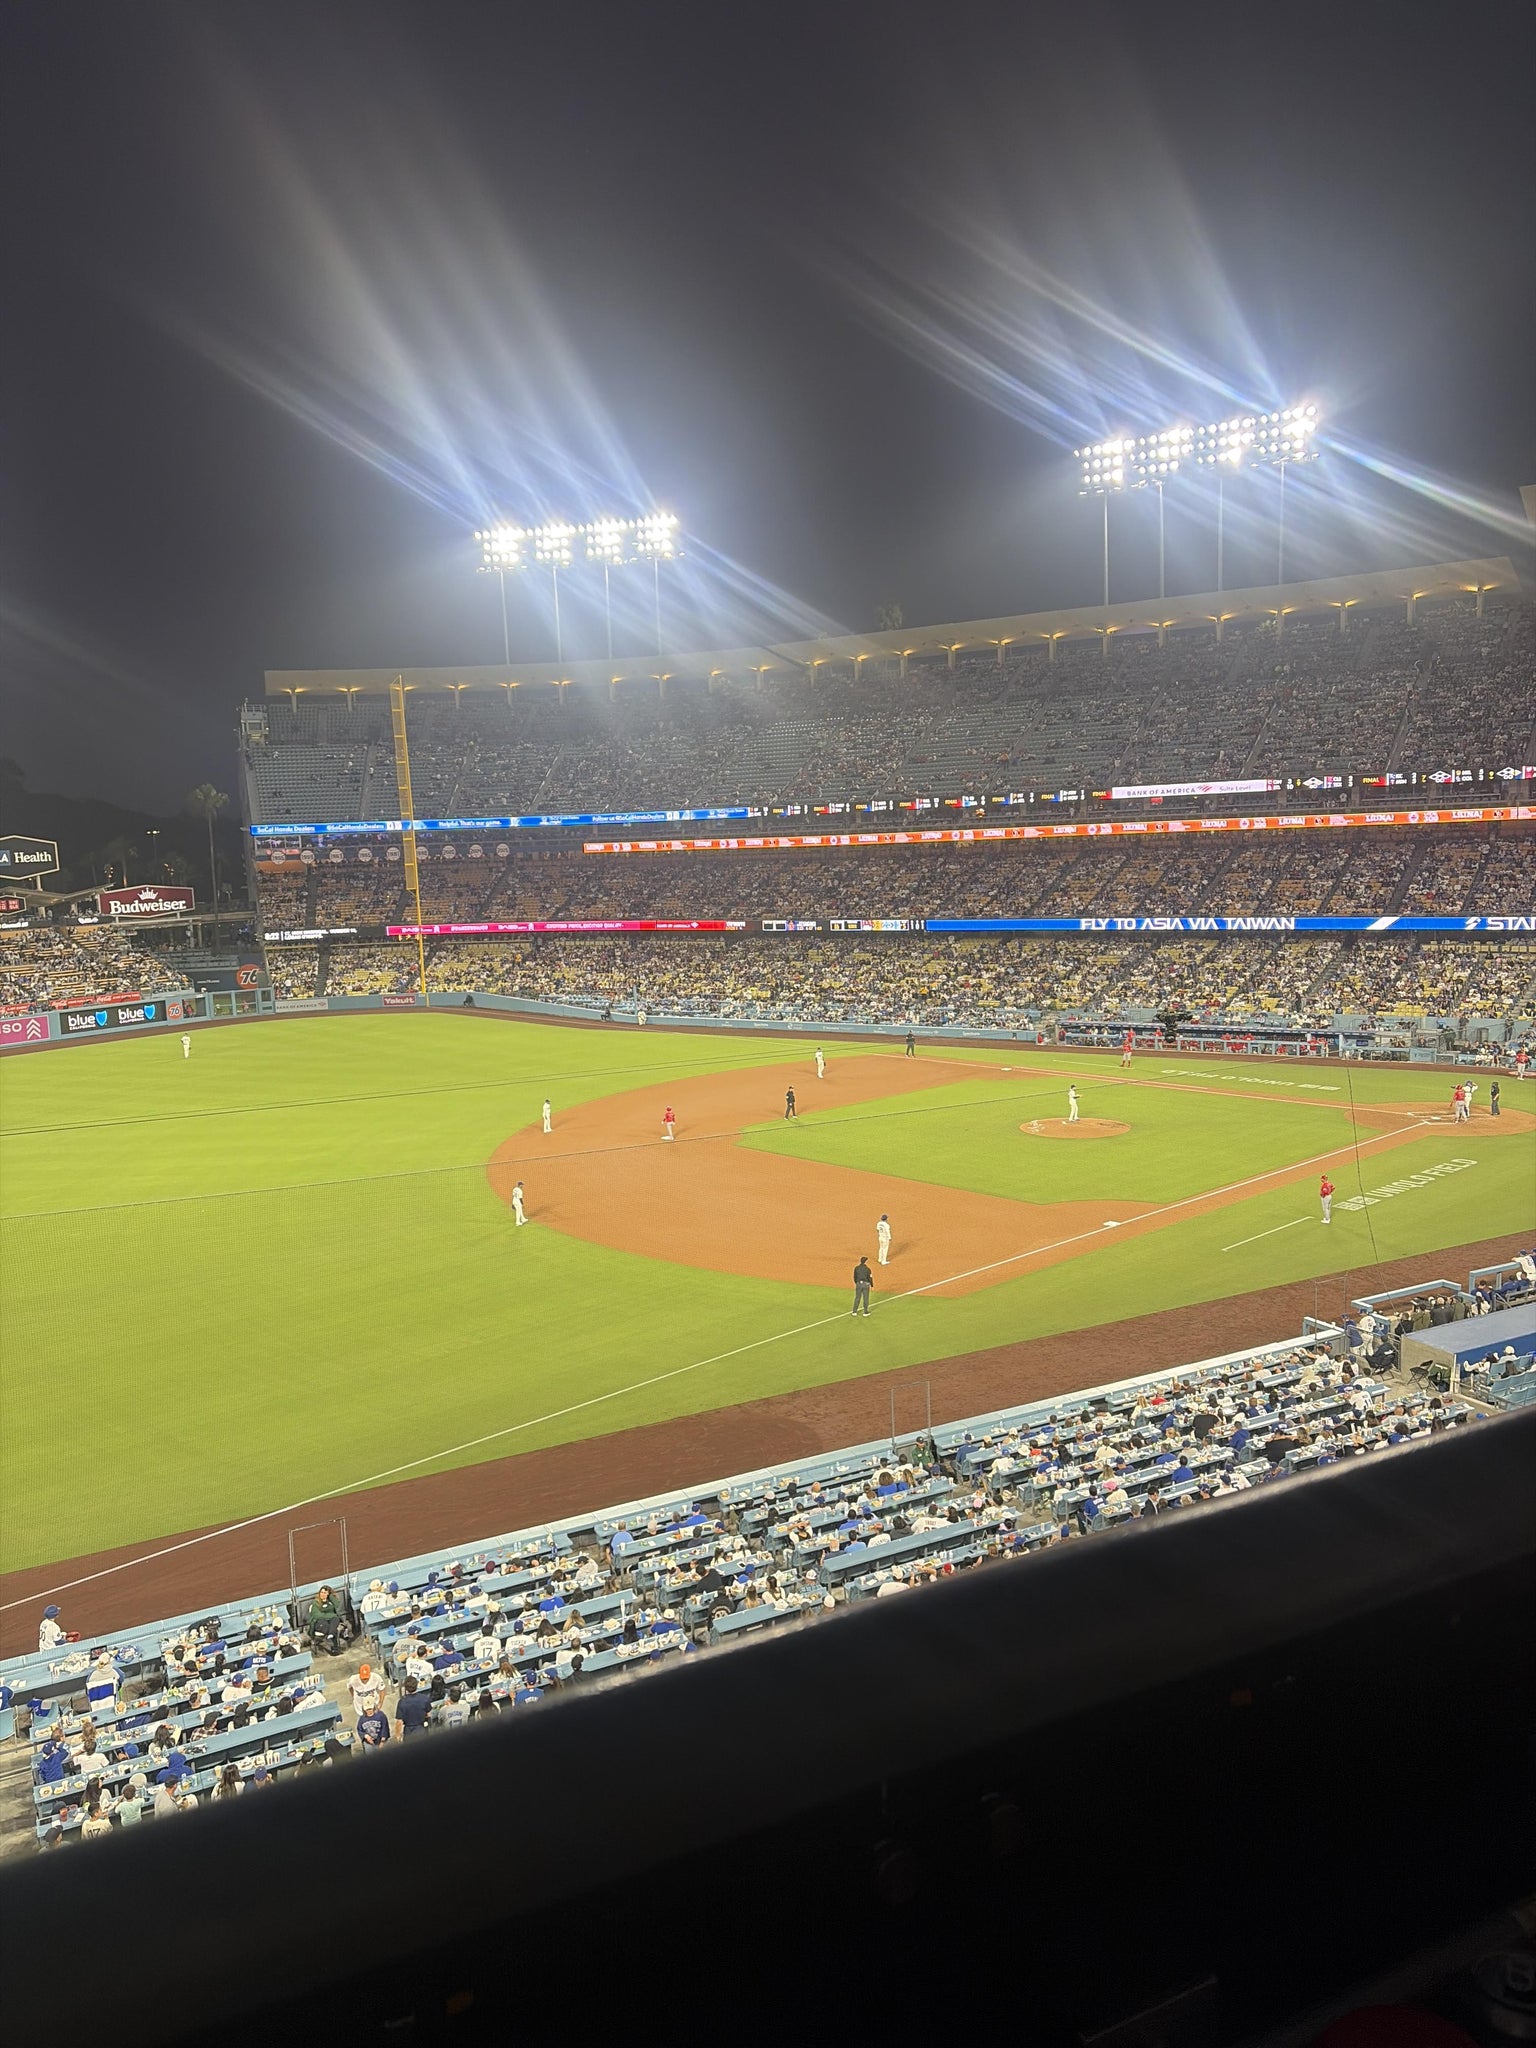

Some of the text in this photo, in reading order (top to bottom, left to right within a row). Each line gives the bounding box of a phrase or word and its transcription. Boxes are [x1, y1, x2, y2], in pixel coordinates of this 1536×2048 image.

[1160, 787, 1196, 795] AMERICA
[1219, 785, 1234, 793] Suite
[1235, 784, 1251, 792] Level
[275, 825, 293, 833] Honda
[293, 824, 315, 833] Dealers
[13, 851, 52, 863] Health
[109, 898, 187, 915] Budweiser
[1080, 917, 1295, 930] FLY TO ASIA VIA TAIWAN
[240, 969, 257, 985] 76
[384, 996, 415, 1005] Yakult
[118, 1007, 145, 1020] blue
[169, 1007, 180, 1016] 76
[68, 1014, 96, 1027] blue
[1365, 1158, 1478, 1198] UNIQLO FIELD
[371, 1600, 380, 1611] 17
[482, 1647, 493, 1657] 17
